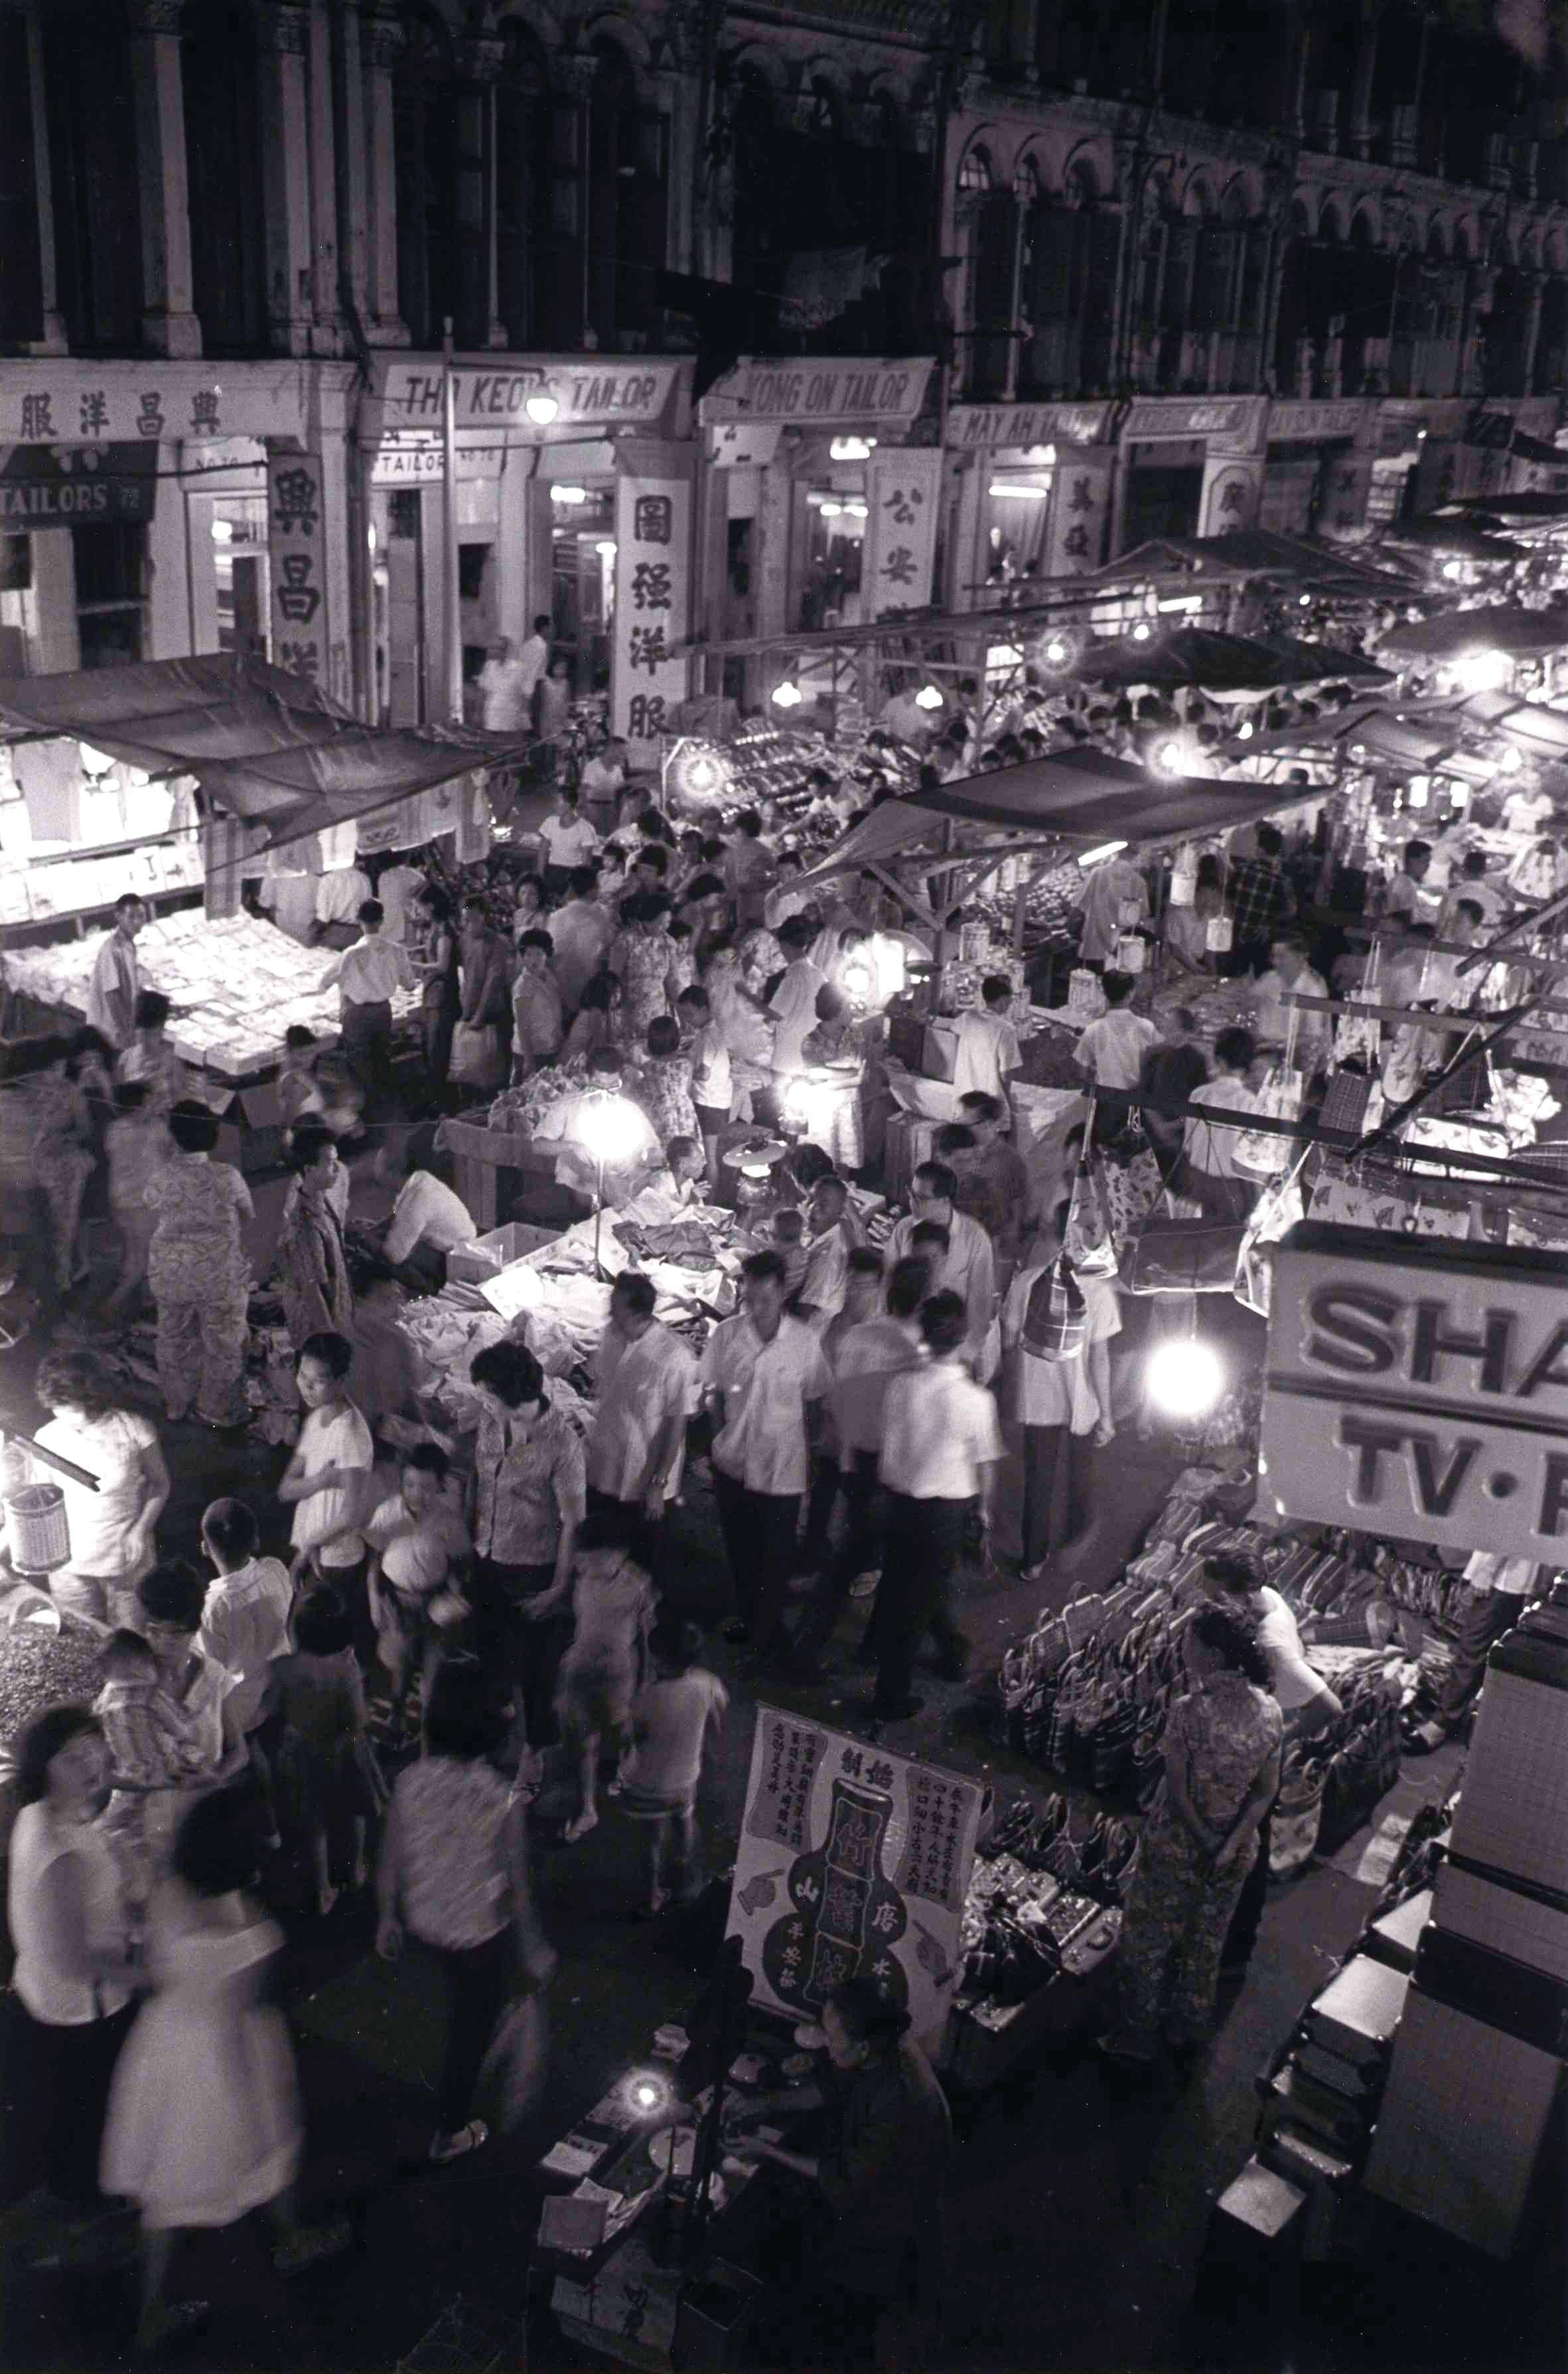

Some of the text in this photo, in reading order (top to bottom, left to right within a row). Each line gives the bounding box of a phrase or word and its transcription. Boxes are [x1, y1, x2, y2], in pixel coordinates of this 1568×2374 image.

[571, 376, 657, 411] TAILOR
[805, 374, 839, 411] ON
[840, 373, 910, 411] TAILOR
[0, 483, 107, 516] TAILORS
[879, 488, 922, 609] 公安
